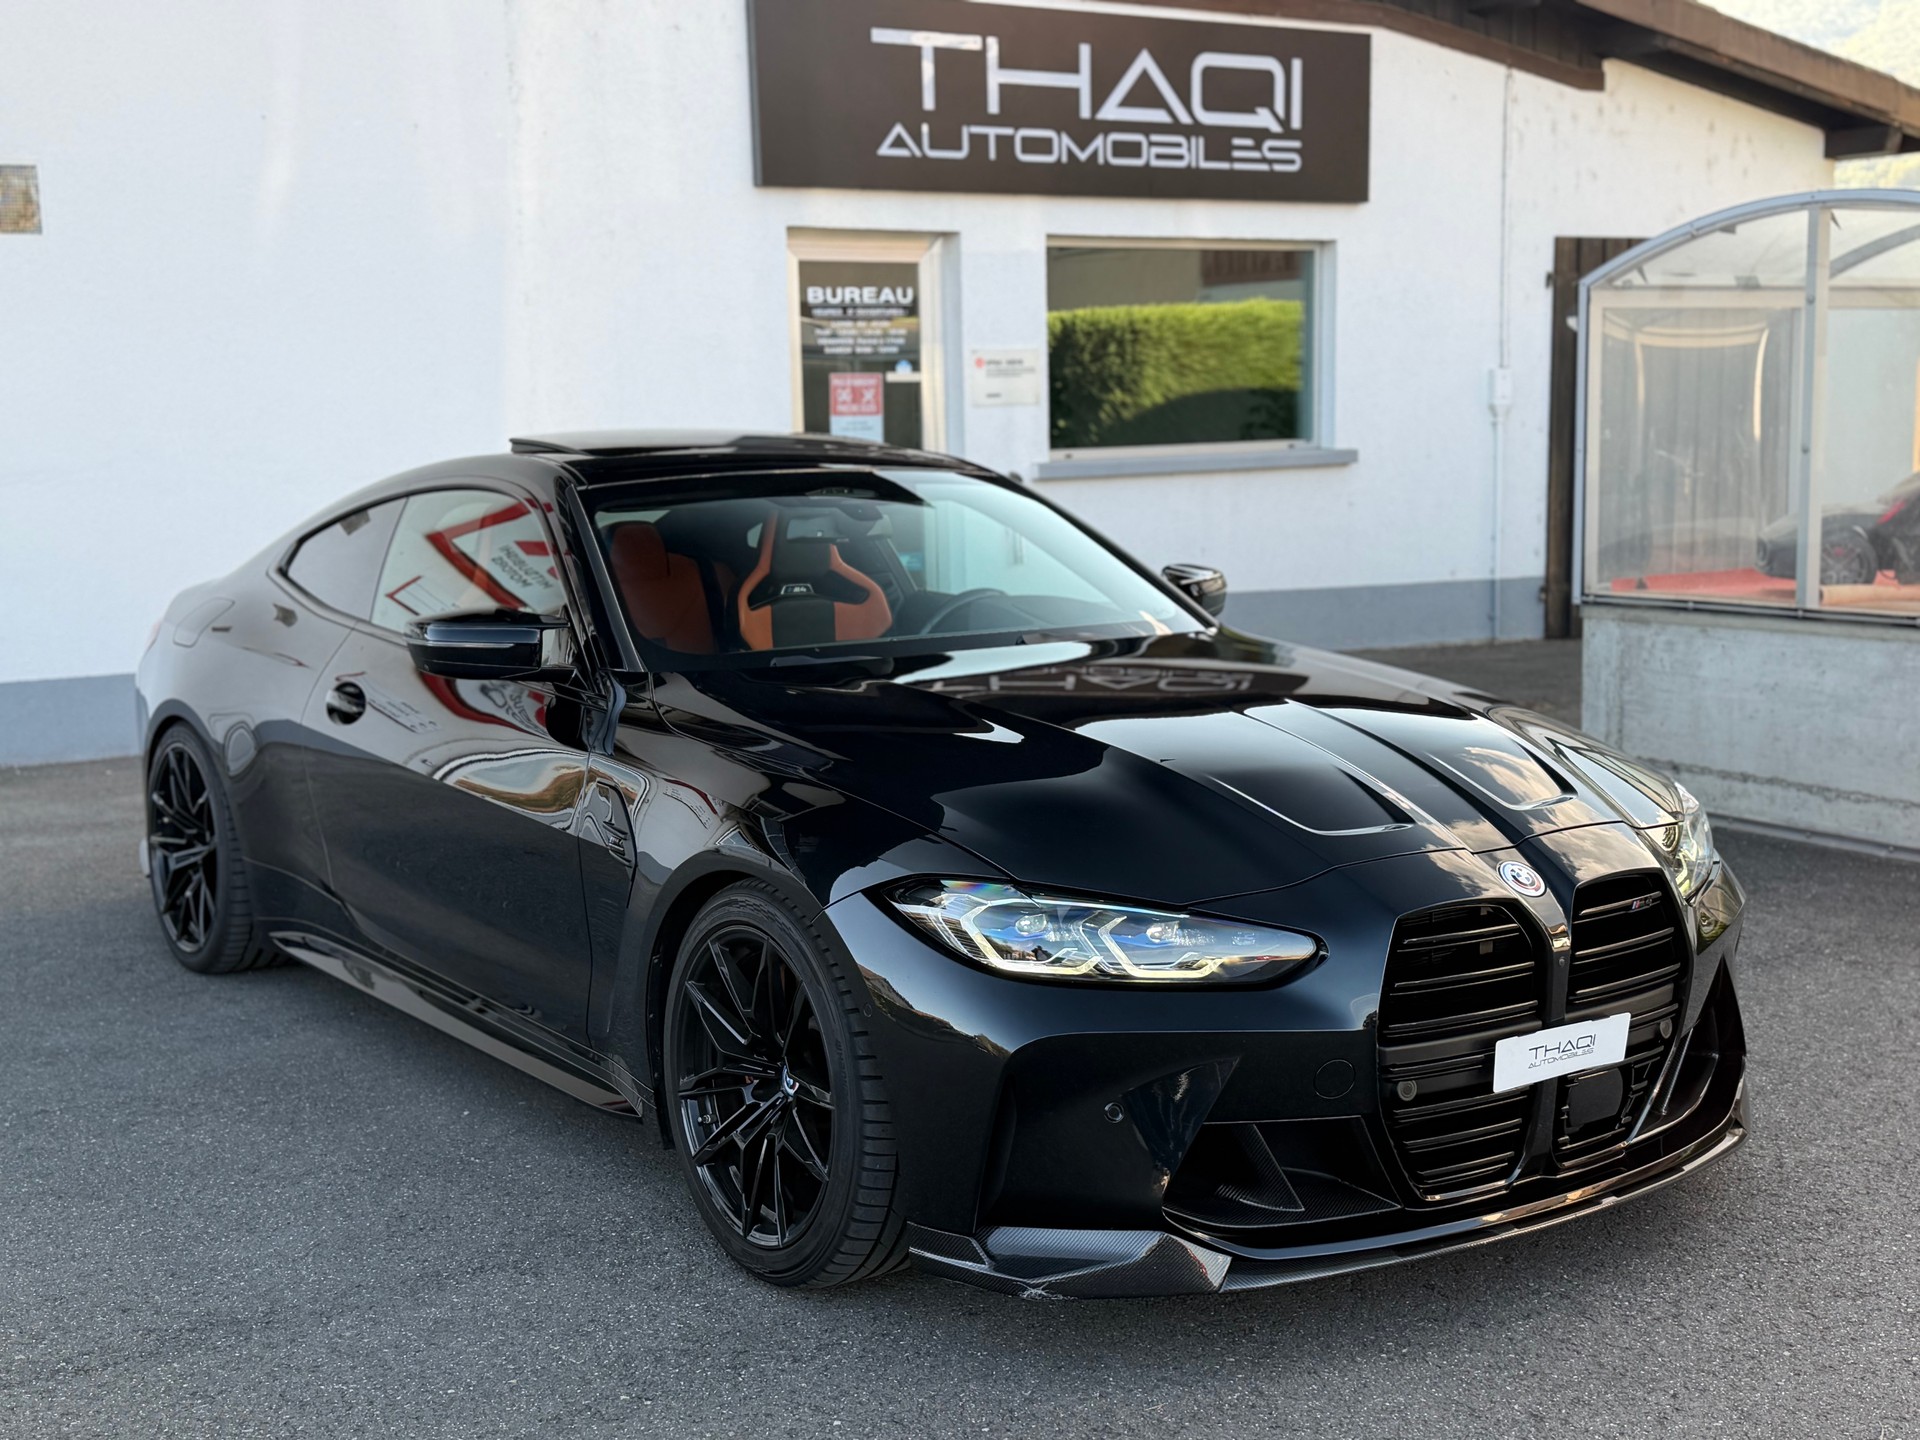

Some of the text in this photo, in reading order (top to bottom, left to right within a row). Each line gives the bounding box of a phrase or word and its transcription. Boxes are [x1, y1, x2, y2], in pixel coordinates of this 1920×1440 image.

[871, 27, 1303, 132] THAQI
[877, 122, 1302, 172] AUTOMOBILES
[807, 286, 913, 304] BUREAU
[1528, 1048, 1594, 1069] AUTOMOBILES
[1529, 1034, 1596, 1060] THAQI
